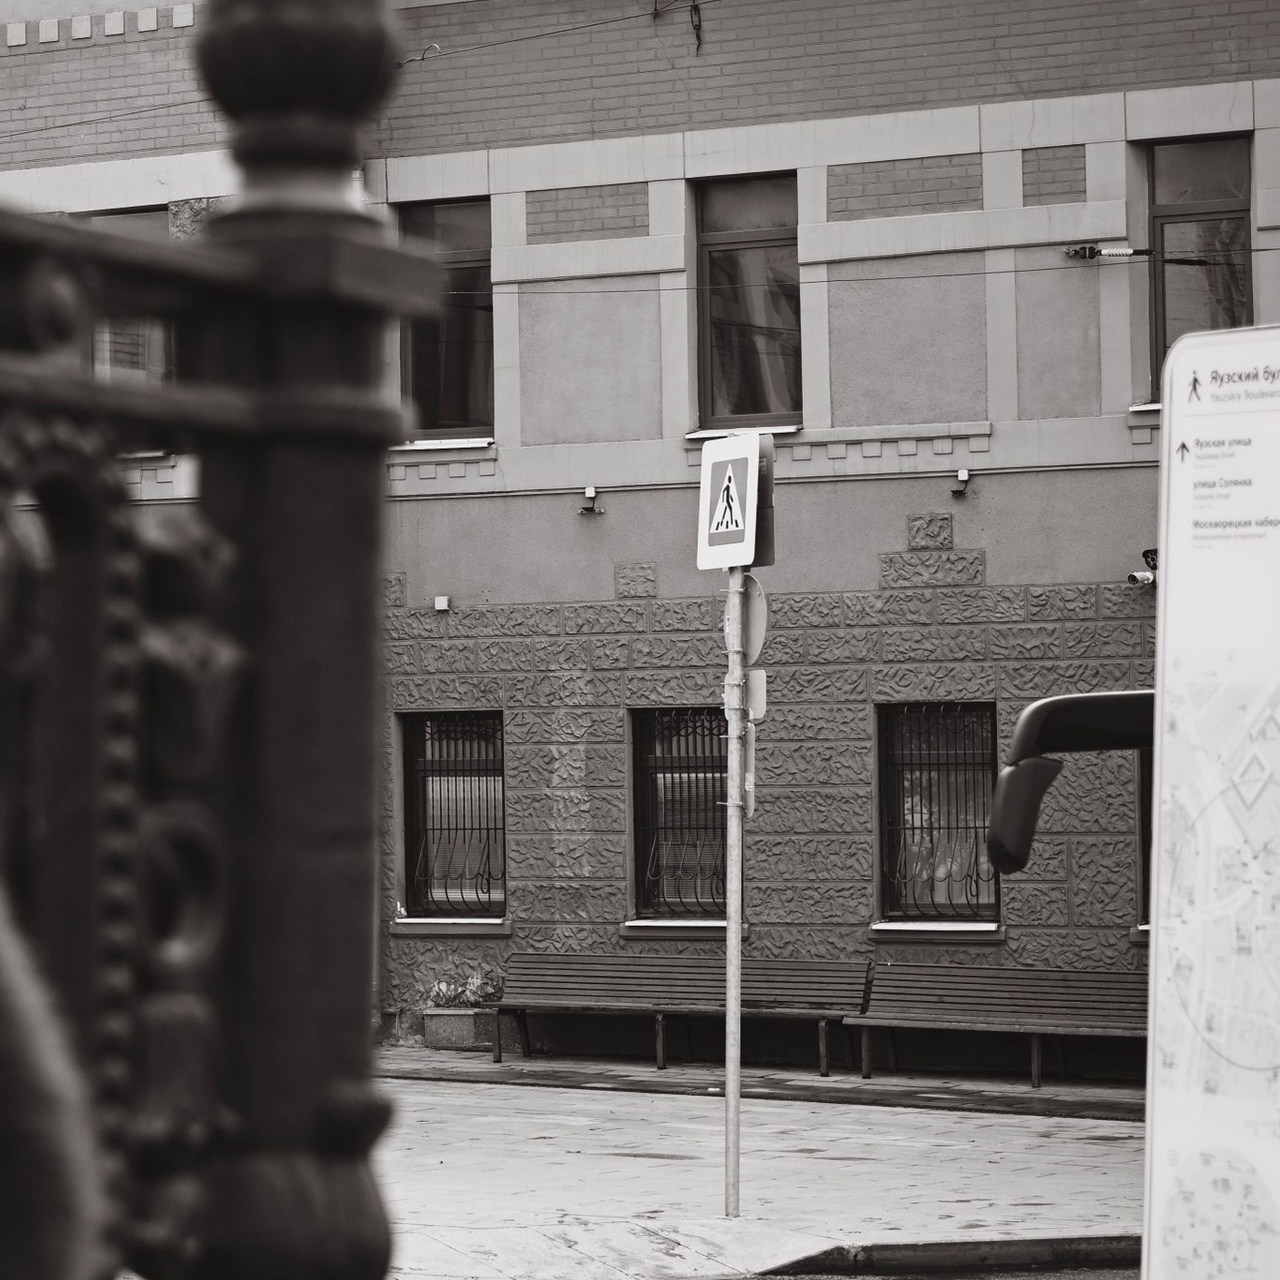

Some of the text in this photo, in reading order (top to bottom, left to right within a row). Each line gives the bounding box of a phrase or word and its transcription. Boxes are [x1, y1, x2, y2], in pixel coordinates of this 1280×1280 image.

[1210, 367, 1259, 388] Яузский
[1194, 437, 1252, 450] Яузская улица
[1193, 477, 1252, 491] улица Солянка
